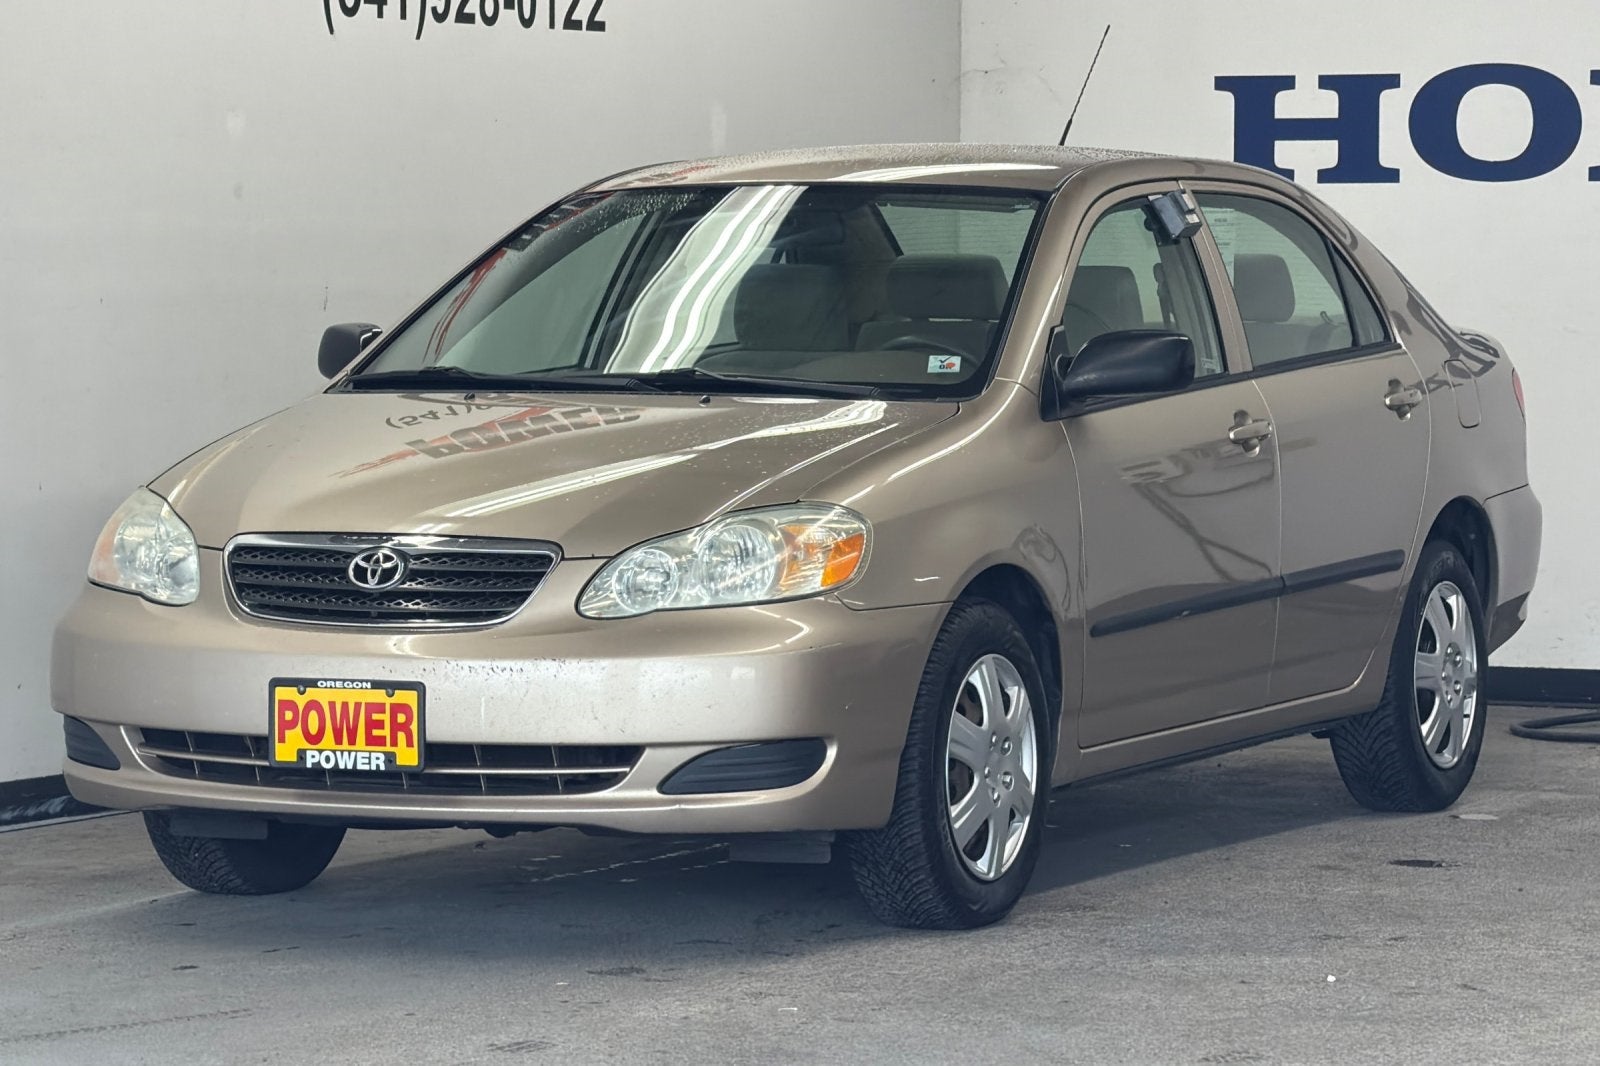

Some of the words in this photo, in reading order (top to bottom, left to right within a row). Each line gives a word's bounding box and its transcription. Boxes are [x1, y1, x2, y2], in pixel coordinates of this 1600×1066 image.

[1214, 63, 1600, 184] HO
[317, 680, 371, 689] OREGON
[278, 699, 415, 748] POWER
[306, 750, 385, 771] POWER
